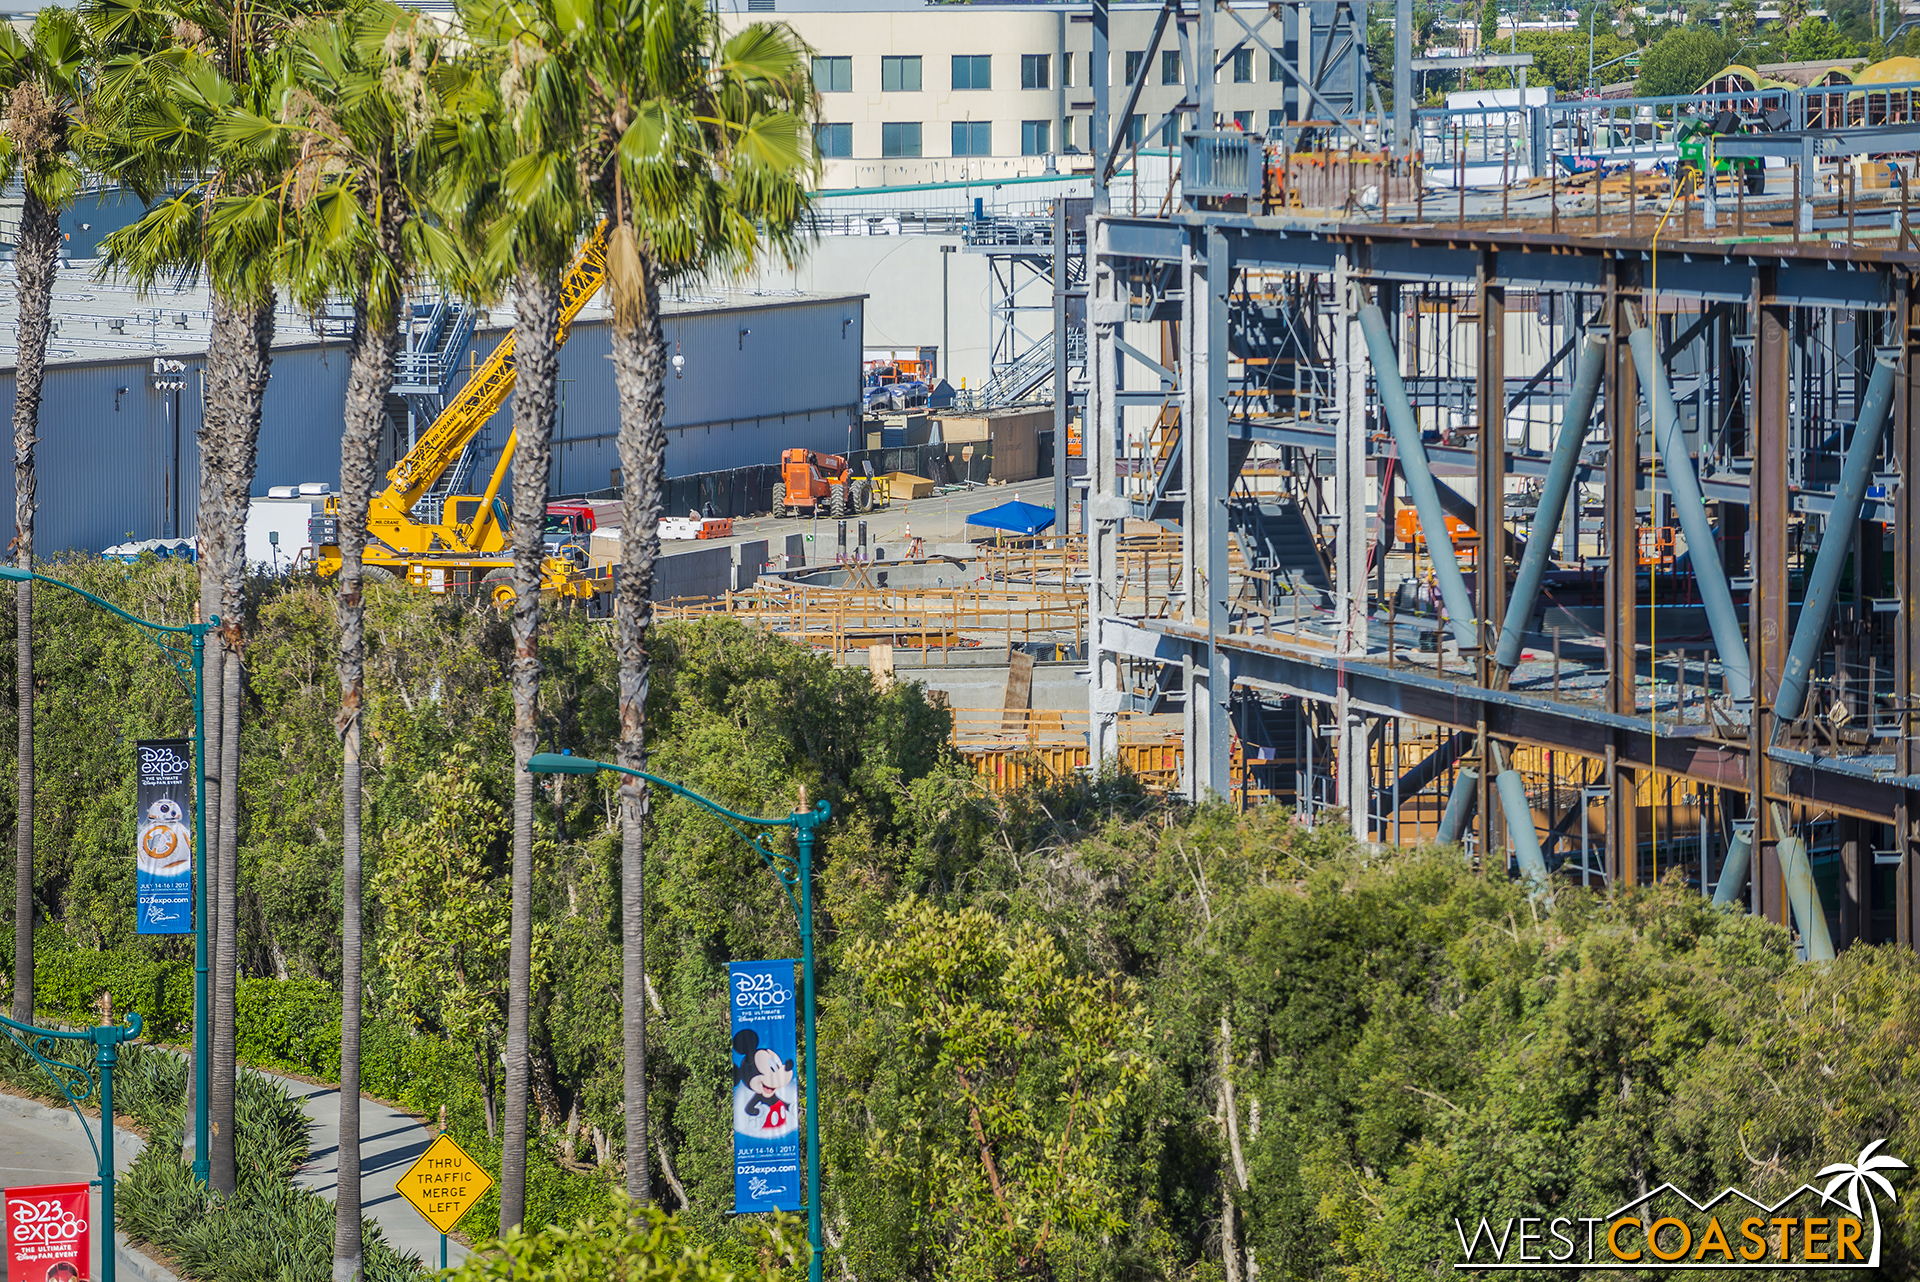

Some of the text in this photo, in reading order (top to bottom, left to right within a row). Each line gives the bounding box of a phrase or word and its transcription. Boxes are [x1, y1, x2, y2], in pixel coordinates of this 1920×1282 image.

[431, 412, 458, 444] MR. CRANE
[138, 746, 173, 762] D23
[141, 760, 184, 777] expo
[139, 897, 189, 905] D23expo.com
[732, 972, 774, 992] D23
[736, 990, 786, 1010] expo
[737, 1147, 754, 1155] JULY
[756, 1146, 774, 1154] 14-16
[780, 1145, 796, 1153] 2017
[427, 1158, 462, 1168] THRU
[737, 1165, 797, 1175] D23expo.com
[417, 1172, 472, 1184] TRAFFIC
[422, 1187, 466, 1198] MERGE
[8, 1199, 63, 1224] D23
[429, 1202, 460, 1213] LEFT
[13, 1220, 79, 1245] expo
[14, 1252, 37, 1262] Disney
